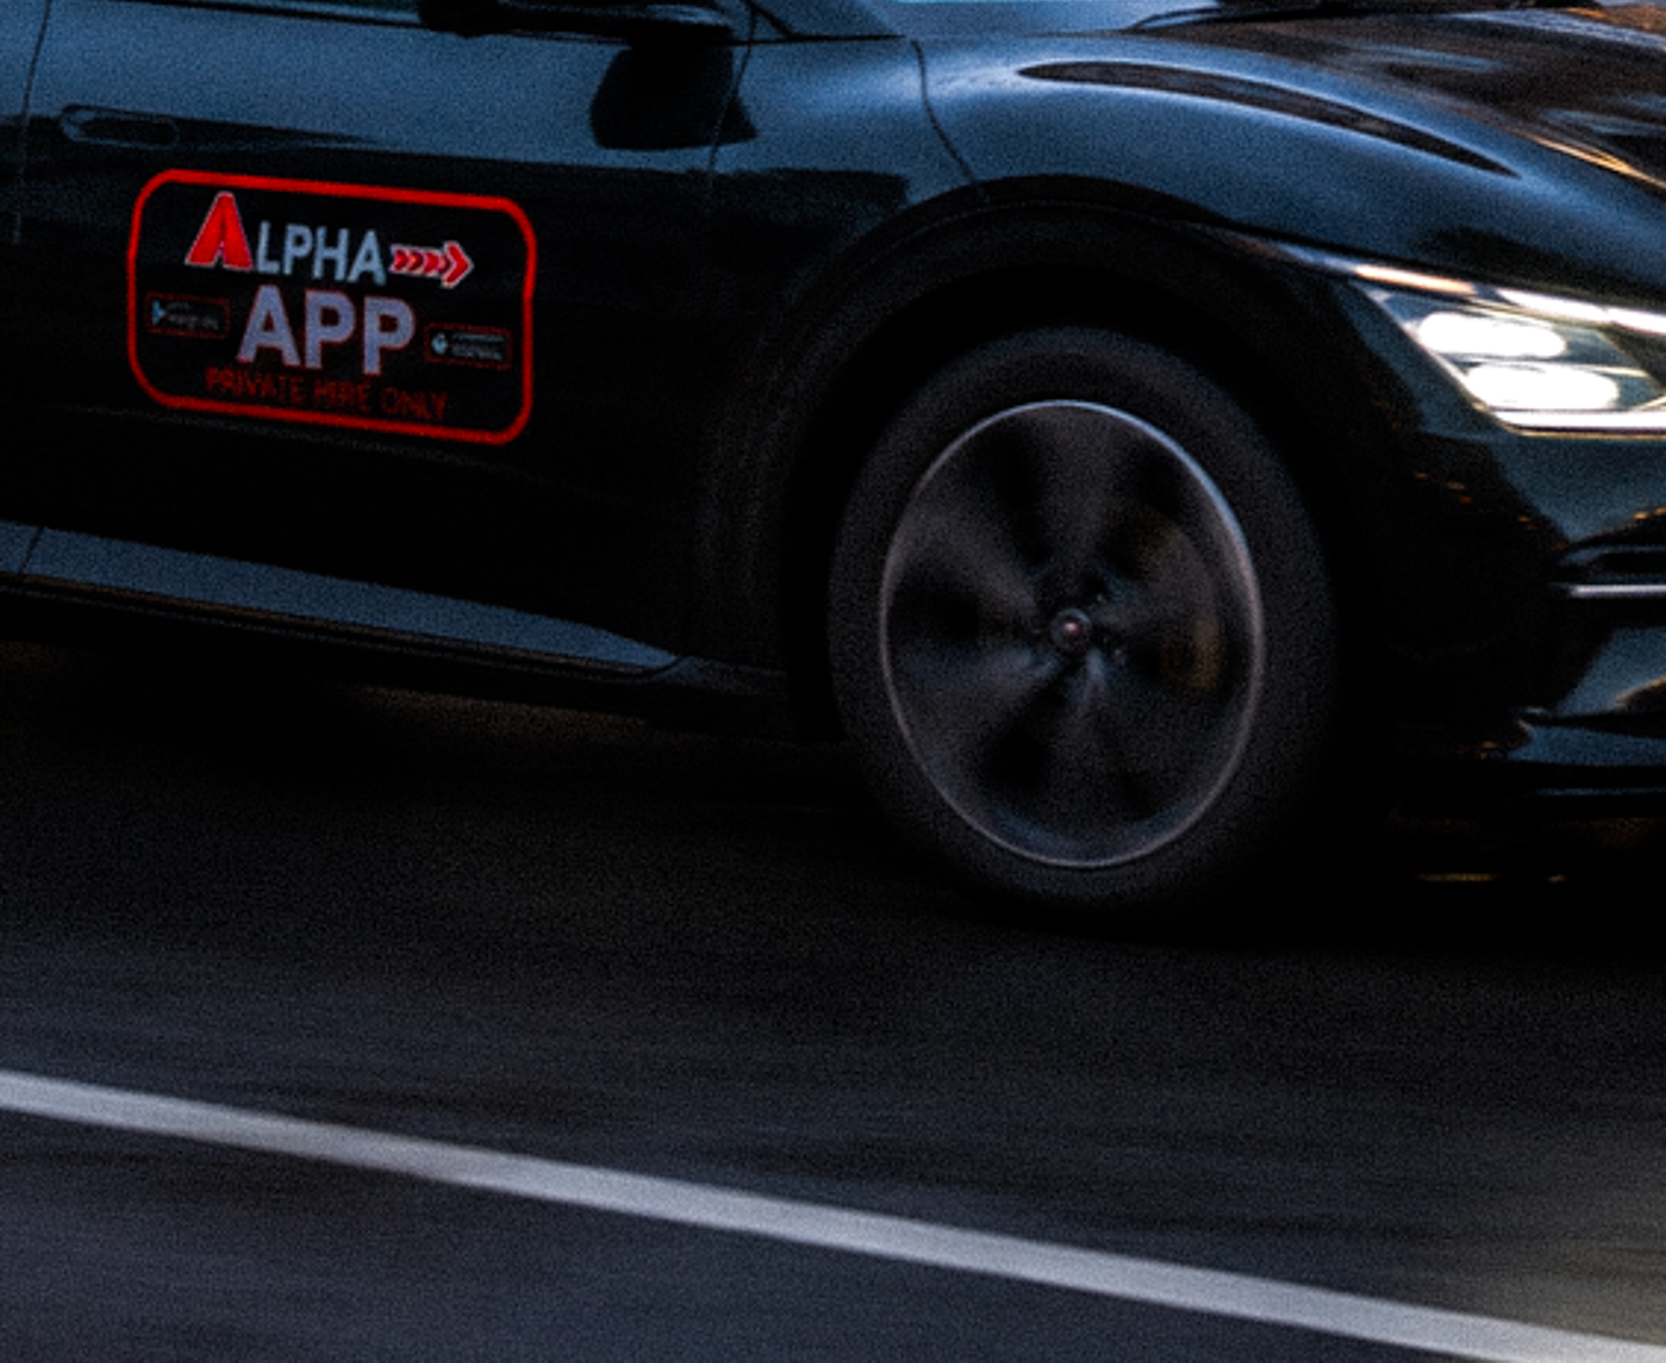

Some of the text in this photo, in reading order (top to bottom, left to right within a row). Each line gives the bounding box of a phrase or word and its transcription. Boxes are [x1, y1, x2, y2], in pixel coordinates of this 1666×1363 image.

[184, 191, 387, 286] ALPHA
[236, 283, 416, 376] APP
[204, 366, 450, 420] PRIVATE HIRE ONLY
